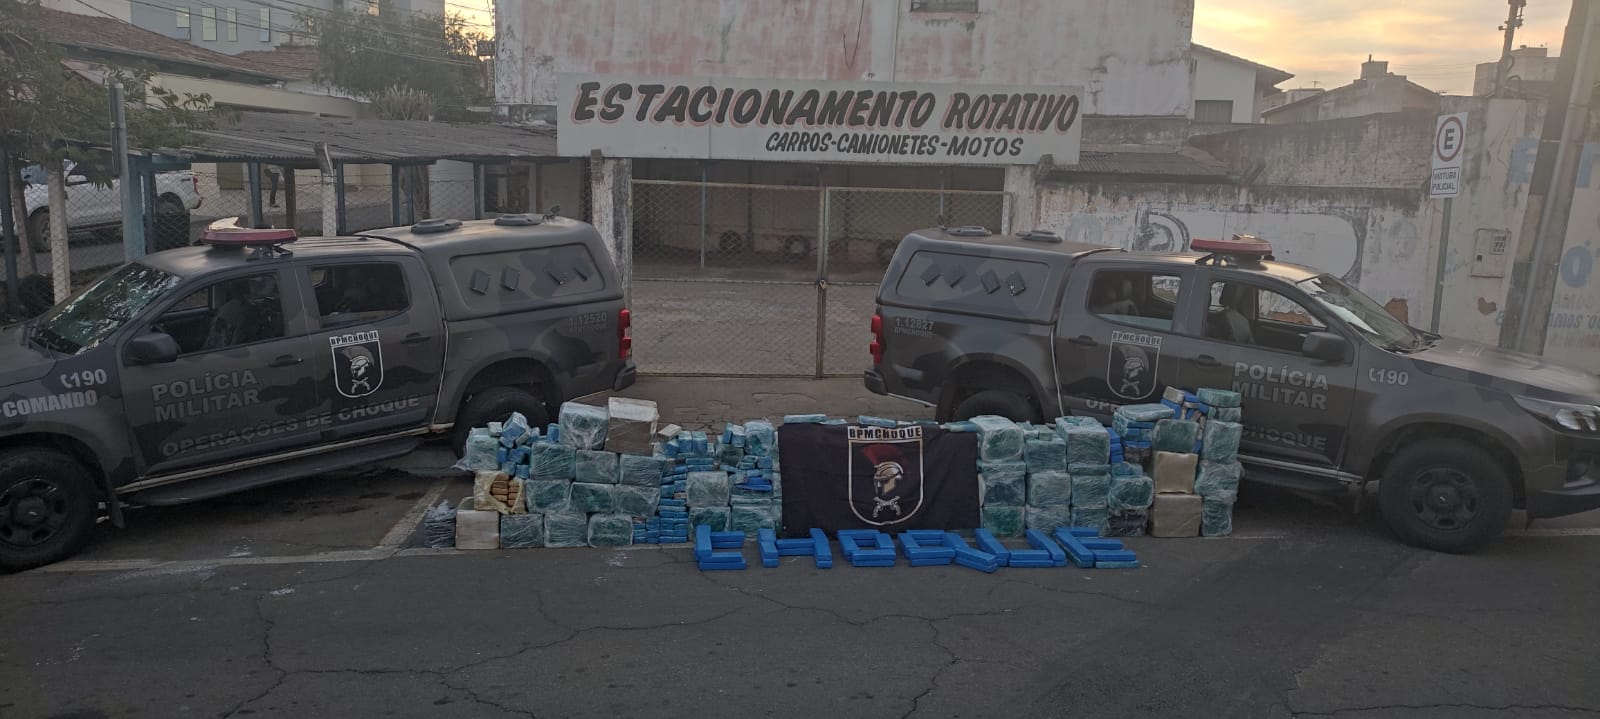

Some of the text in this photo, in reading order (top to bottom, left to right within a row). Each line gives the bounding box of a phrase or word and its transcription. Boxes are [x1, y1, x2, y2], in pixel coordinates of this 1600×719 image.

[572, 81, 1079, 133] ESTACIONAMENTO ROTATIVO
[1443, 128, 1455, 150] E
[330, 331, 379, 345] BPMCHOQUE
[895, 317, 935, 331] 1.12827
[71, 368, 107, 388] 190
[151, 368, 259, 402] POLÍCIA
[1234, 361, 1329, 392] POLÍCIA
[1377, 367, 1409, 387] 190
[2, 389, 99, 418] COMANDO
[153, 388, 262, 424] MILITAR
[1232, 381, 1329, 411] MILITAR
[161, 396, 422, 457] OPERAÇÕES DE CHOQUE
[848, 426, 922, 440] BPMCHOQUE
